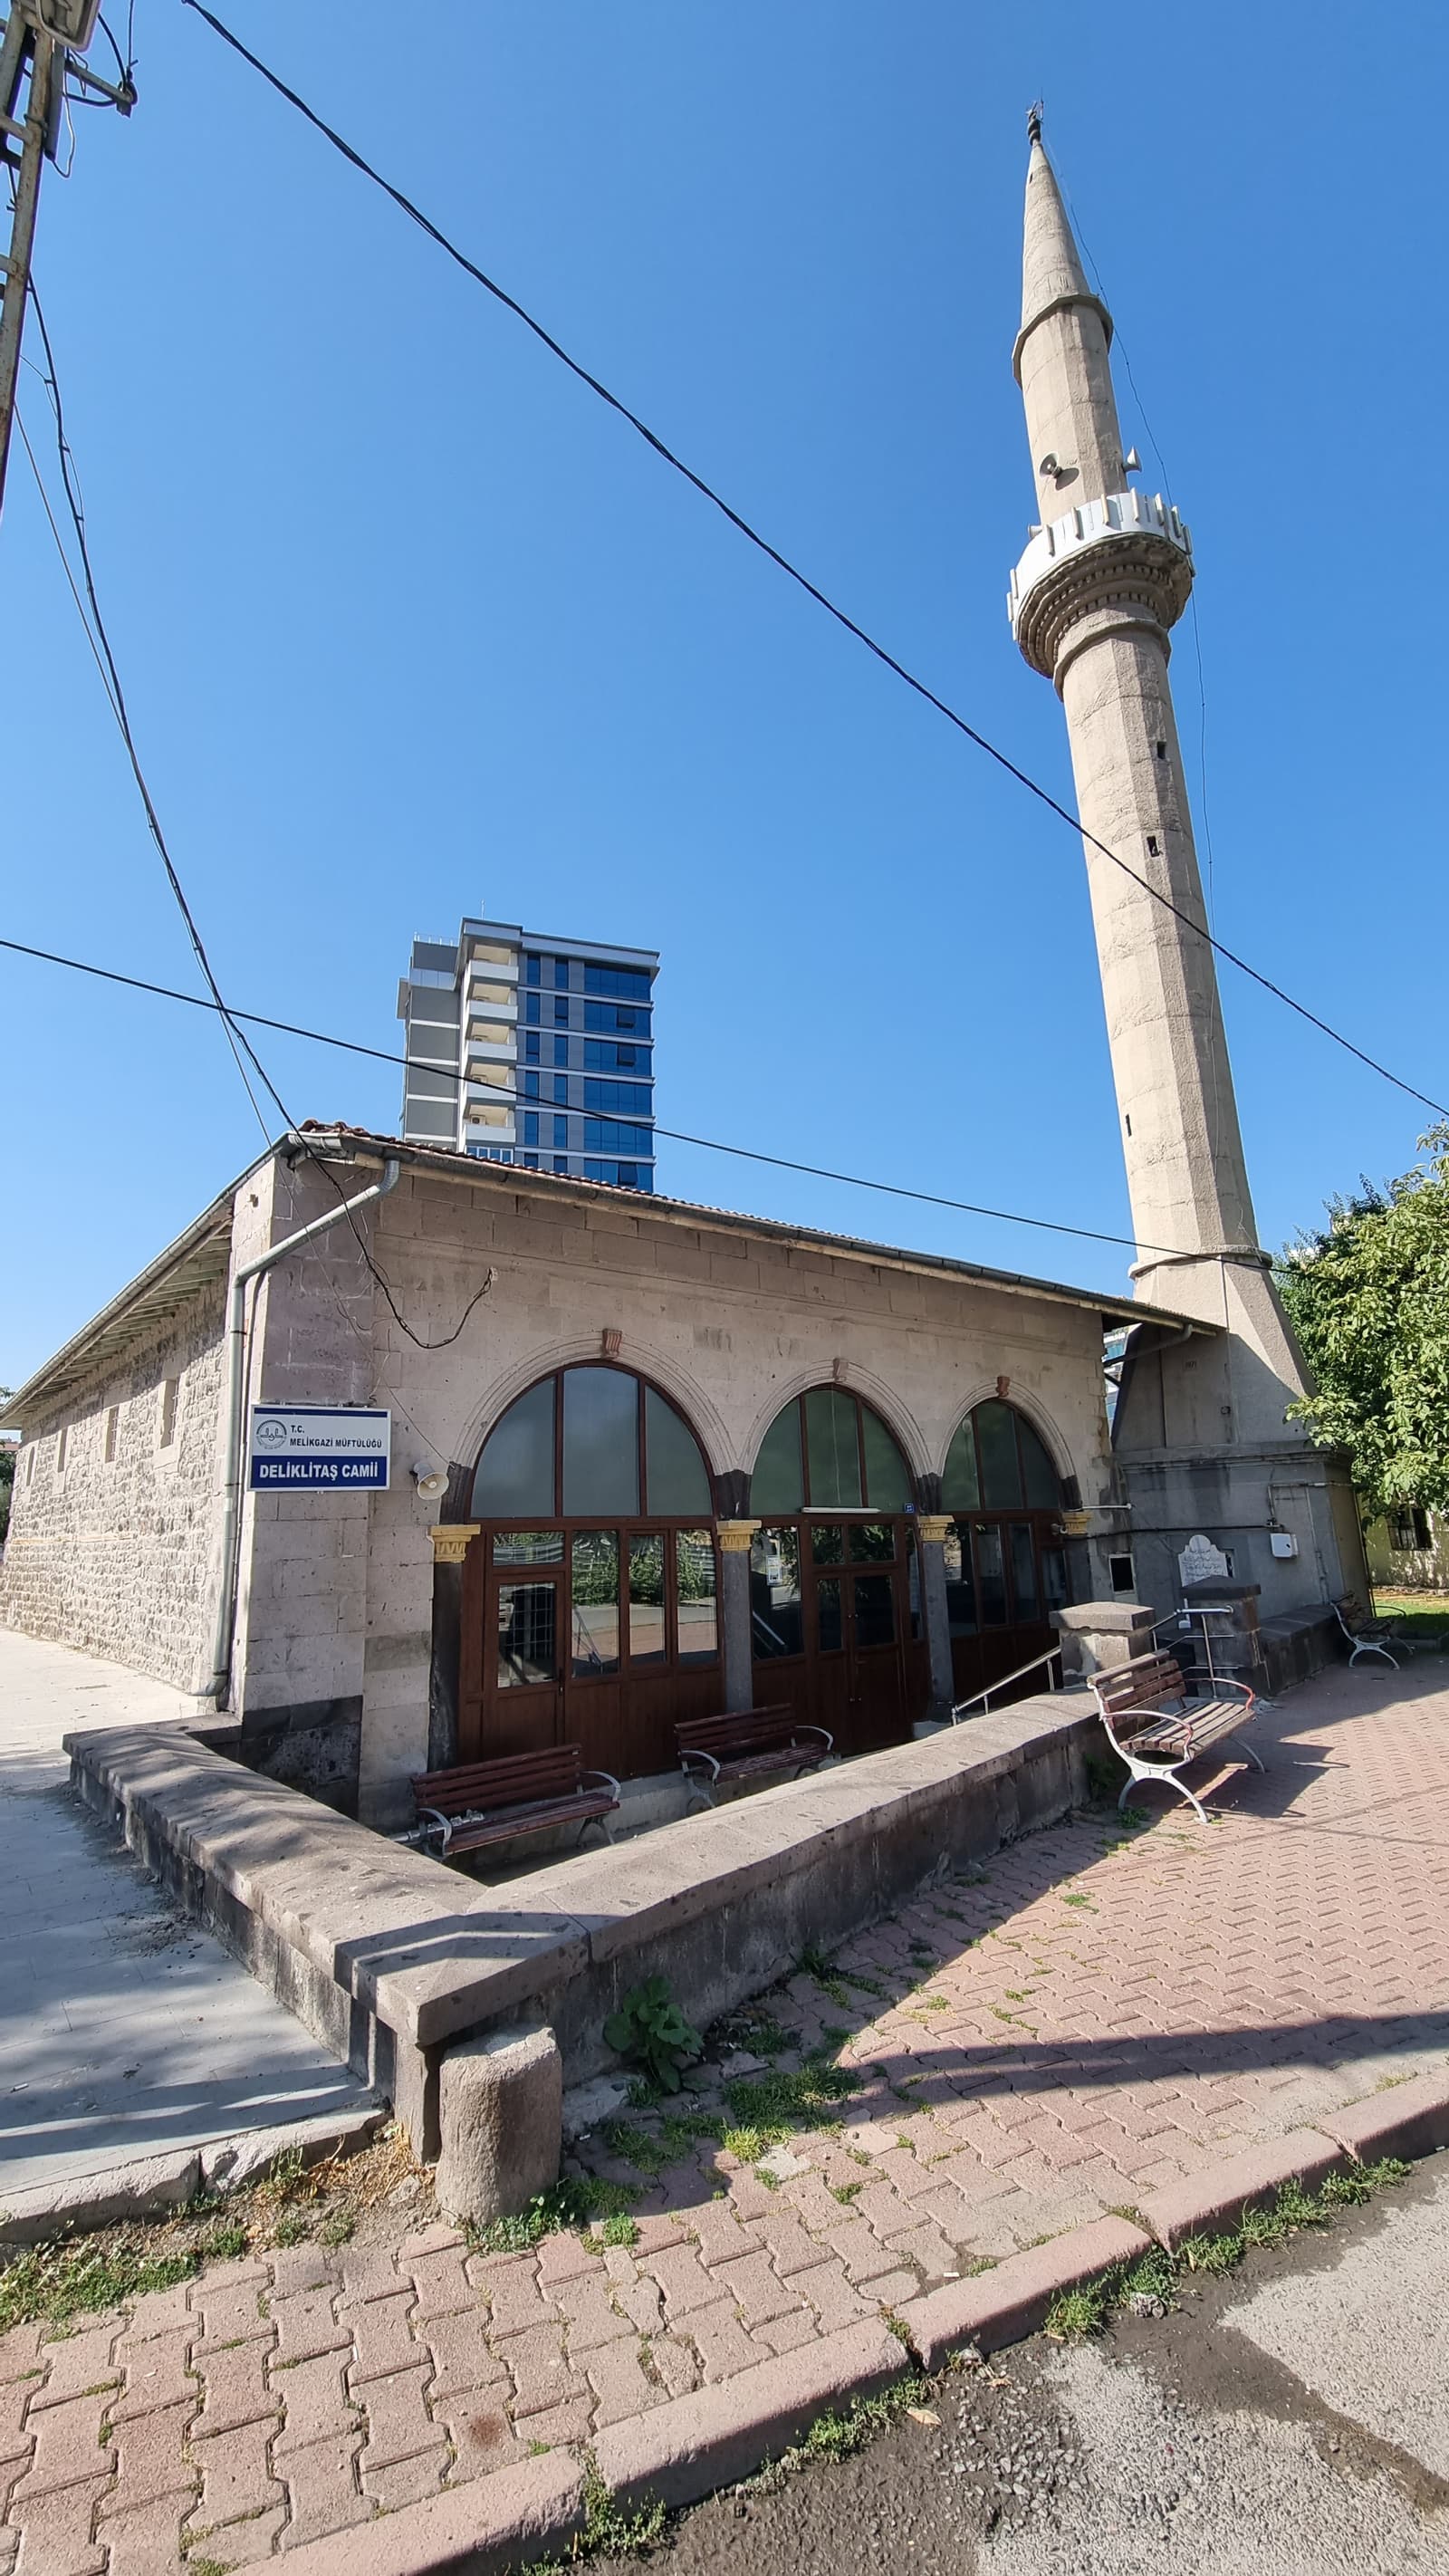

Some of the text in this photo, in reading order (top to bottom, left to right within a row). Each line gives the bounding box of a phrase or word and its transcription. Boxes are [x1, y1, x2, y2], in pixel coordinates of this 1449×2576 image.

[290, 1425, 305, 1434] T.C.
[290, 1436, 333, 1447] MELİKGAZİ
[335, 1437, 382, 1448] MÜFTÜLÜĞÜ
[259, 1461, 379, 1481] DELİKLİTAŞ CAMİİ
